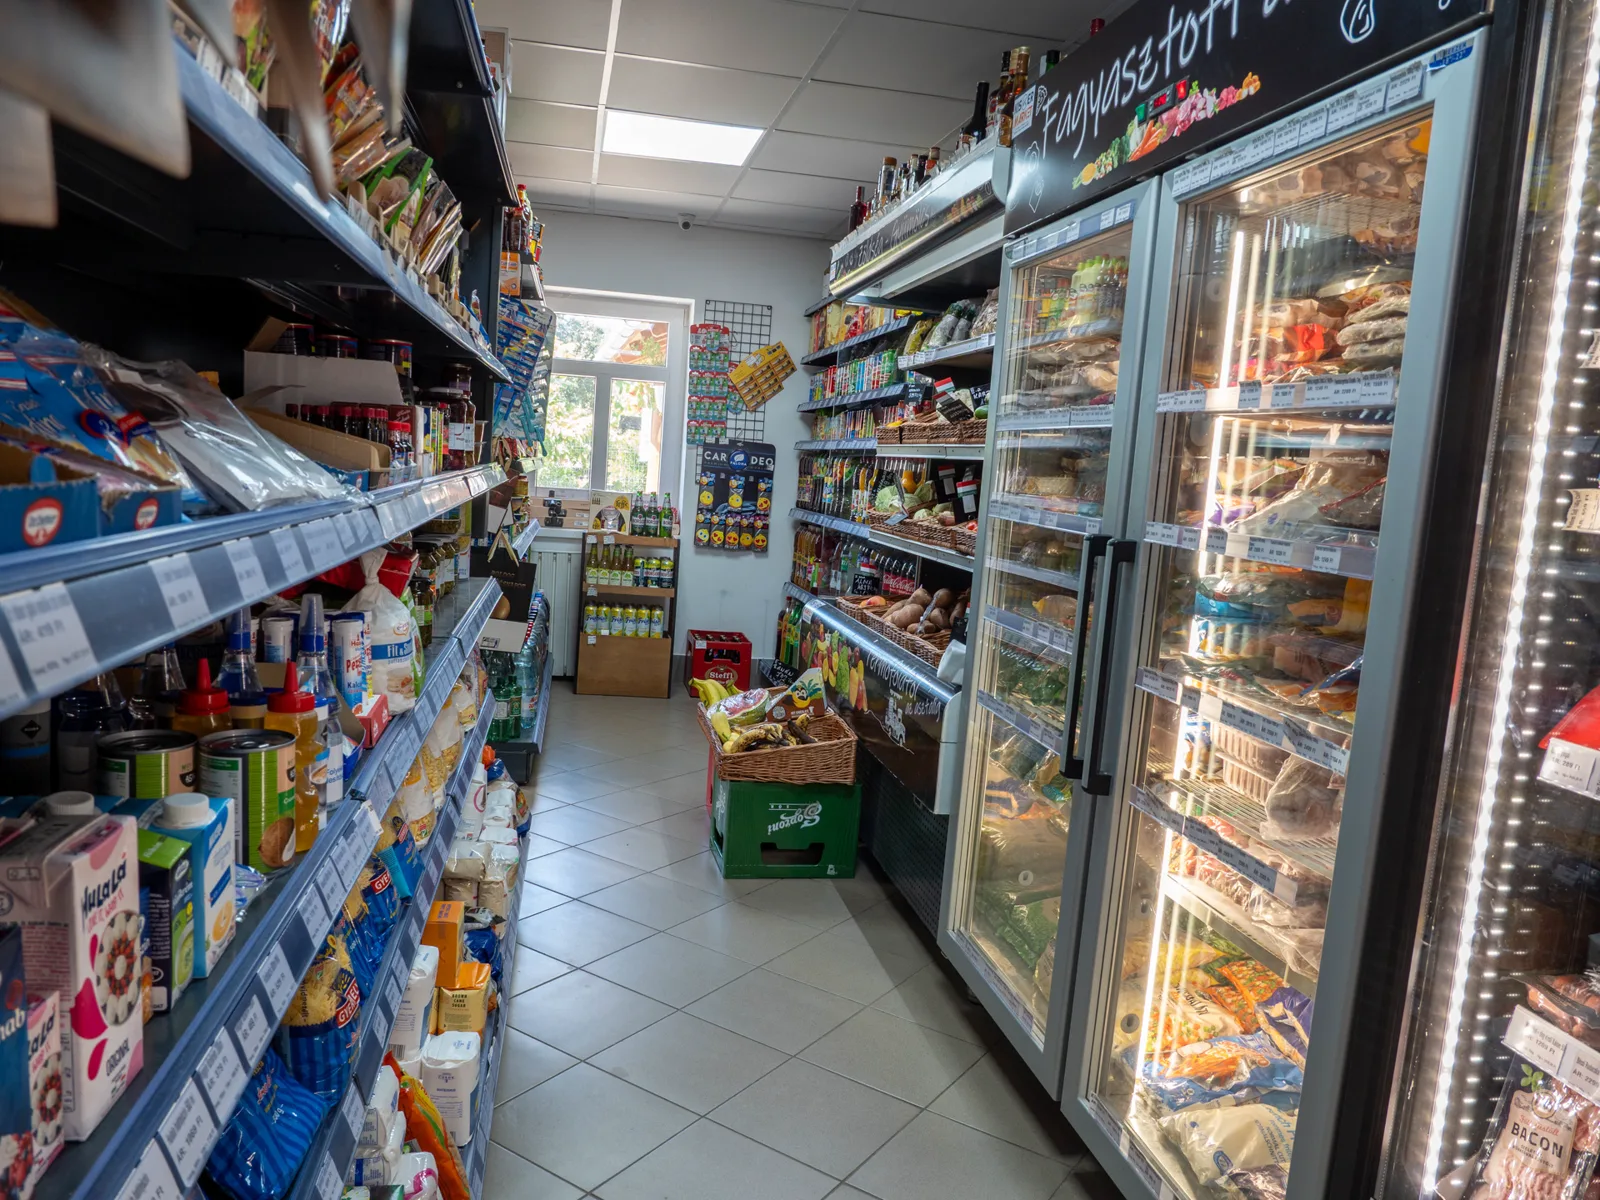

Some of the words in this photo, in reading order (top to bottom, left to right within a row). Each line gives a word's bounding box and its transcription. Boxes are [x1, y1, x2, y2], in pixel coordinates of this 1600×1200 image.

[704, 450, 727, 462] CAR
[751, 456, 774, 466] DEO
[387, 645, 398, 657] Fit
[767, 800, 822, 836] Soproni
[1510, 1122, 1564, 1159] BACON
